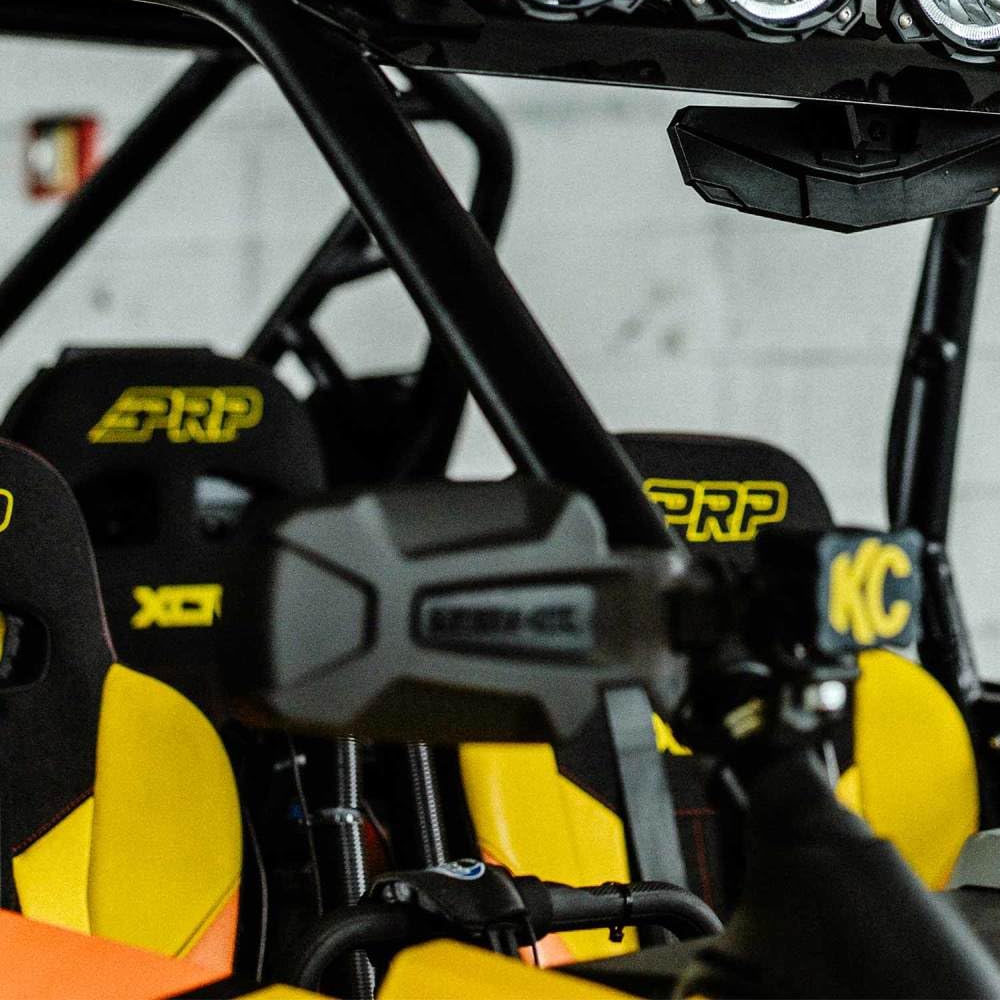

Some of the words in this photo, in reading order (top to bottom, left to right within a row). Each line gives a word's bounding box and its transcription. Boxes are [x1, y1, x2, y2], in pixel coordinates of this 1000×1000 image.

[88, 385, 264, 443] PRP
[642, 477, 788, 543] PRP
[828, 537, 913, 645] KC
